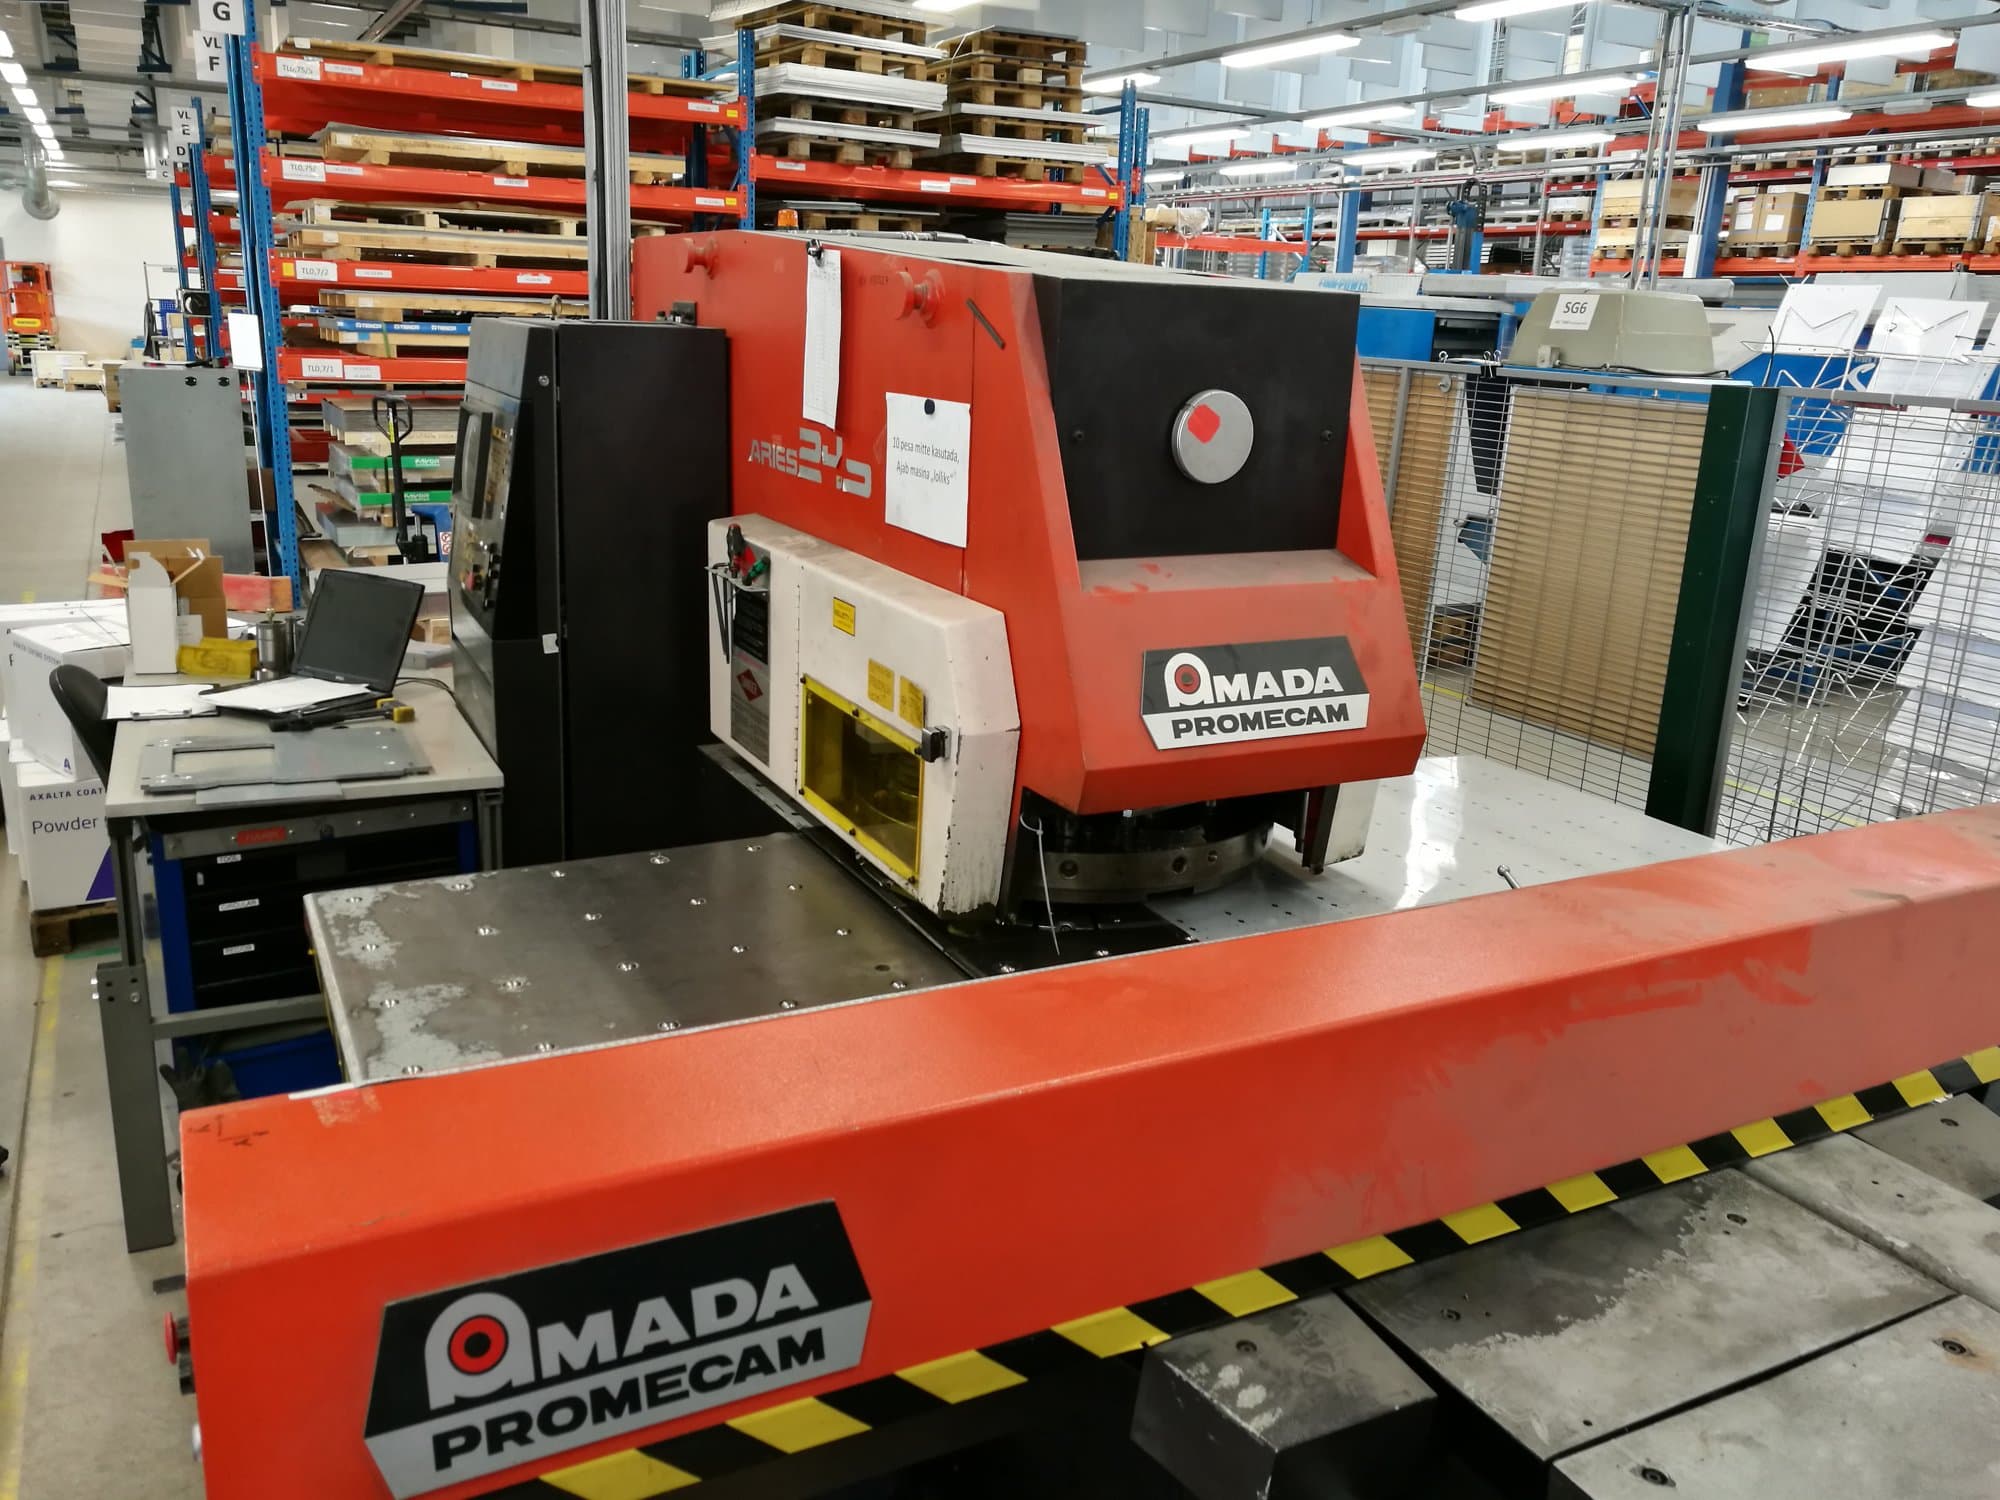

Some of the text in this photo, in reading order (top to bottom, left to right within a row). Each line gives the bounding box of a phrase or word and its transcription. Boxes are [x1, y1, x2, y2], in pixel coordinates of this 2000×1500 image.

[212, 1, 231, 21] G
[203, 36, 222, 49] VL
[209, 56, 220, 72] F
[177, 110, 192, 120] VL
[182, 124, 190, 136] E
[176, 145, 186, 156] D
[1563, 301, 1588, 314] SG6
[748, 439, 798, 476] ARIES
[893, 436, 960, 464] 10 pesa mitte kasutada,
[896, 460, 910, 476] Ajab
[910, 466, 930, 480] masina
[1163, 652, 1345, 708] AMADA
[1171, 702, 1349, 739] PROMECAM
[29, 787, 103, 801] AXALTA COAT
[32, 817, 98, 835] Powder
[424, 1263, 820, 1411] AMADA
[432, 1327, 826, 1472] PROMECAM
